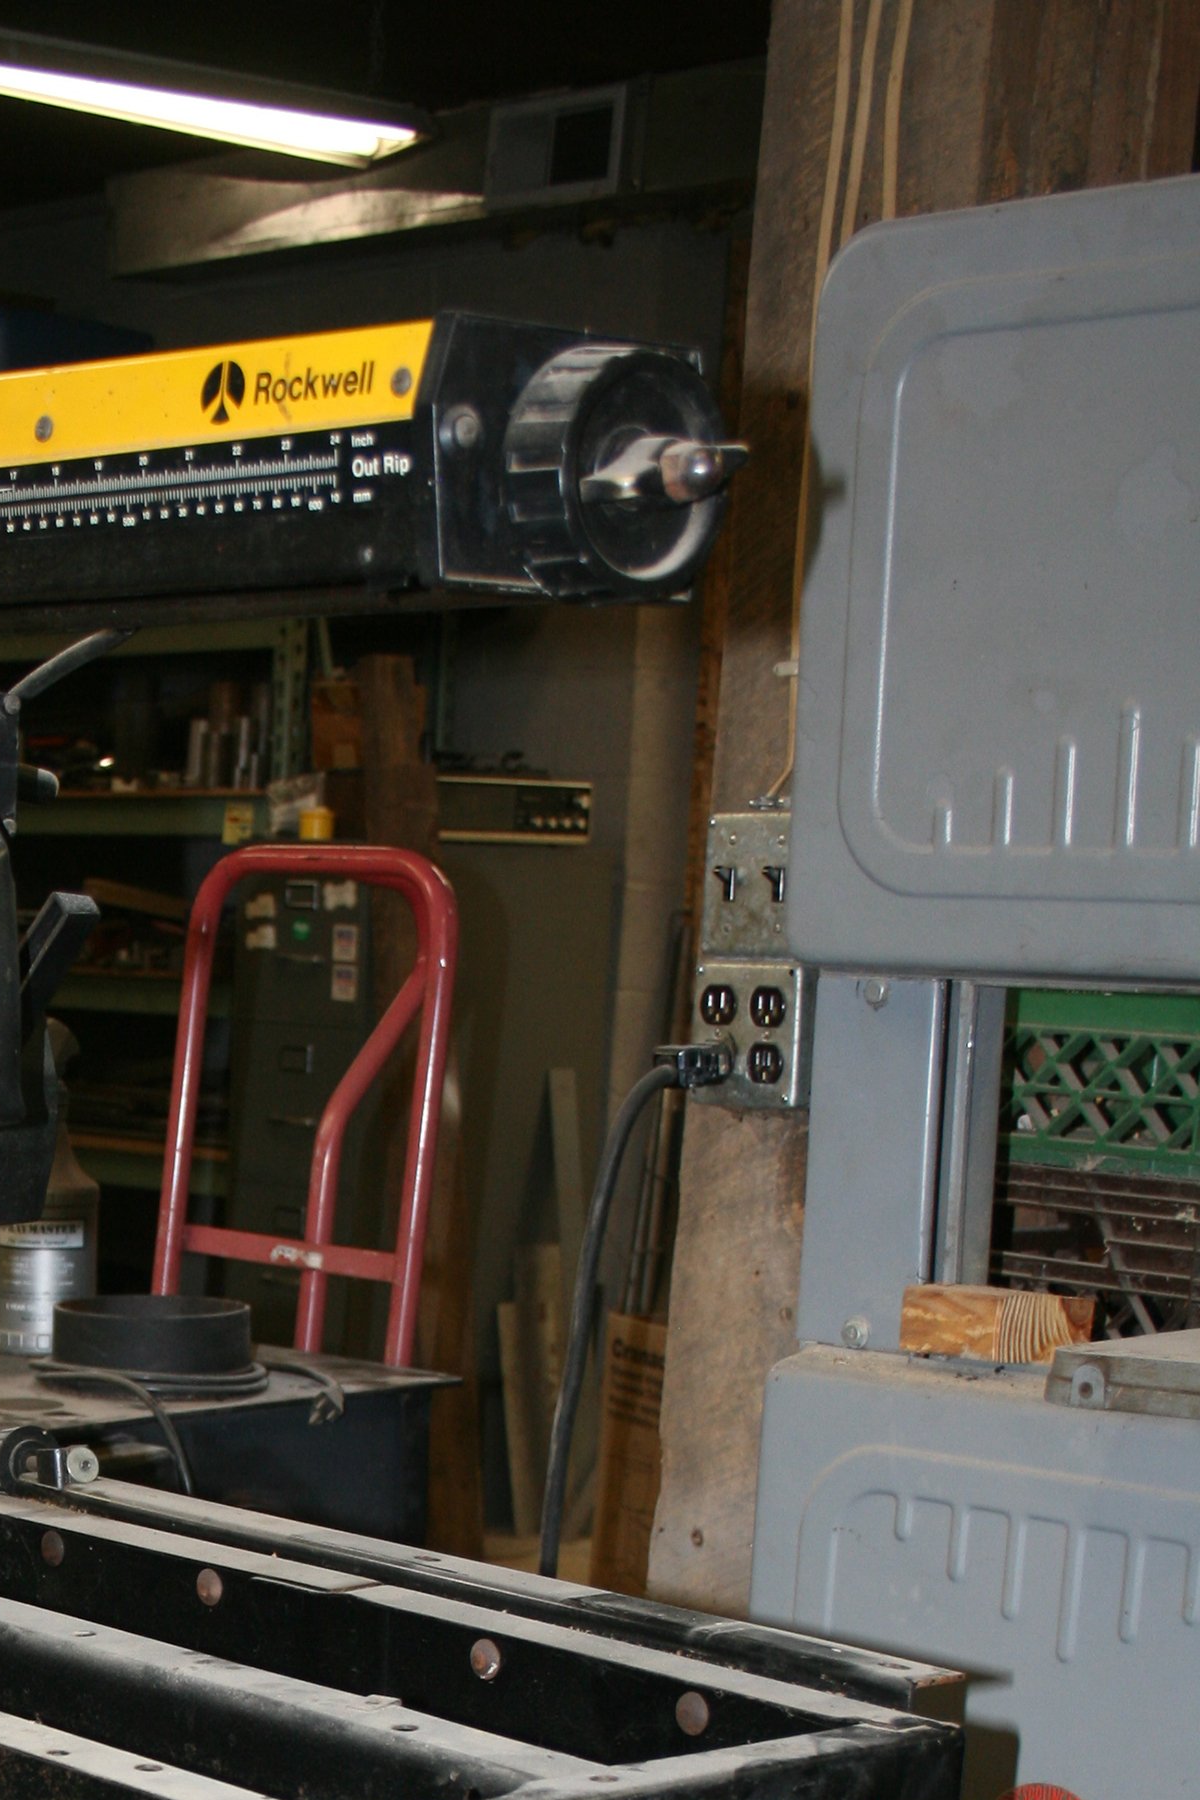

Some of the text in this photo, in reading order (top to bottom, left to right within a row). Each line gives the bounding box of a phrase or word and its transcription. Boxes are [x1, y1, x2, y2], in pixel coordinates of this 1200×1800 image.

[253, 361, 375, 405] Rockwell
[351, 434, 374, 447] Inch
[9, 471, 18, 480] 17
[52, 466, 60, 476] 18
[94, 461, 103, 471] 19
[139, 455, 148, 466] 20
[185, 450, 193, 461] 21
[232, 445, 242, 456] 22
[281, 440, 291, 451] 23
[330, 434, 341, 446] 24
[351, 454, 410, 478] Out Rip
[122, 516, 136, 527] 500
[142, 511, 151, 520] 10
[160, 509, 169, 519] 20
[178, 507, 187, 518] 30
[196, 505, 205, 516] 40
[215, 504, 224, 514] 50
[253, 500, 262, 510] 70
[272, 498, 281, 509] 80
[308, 500, 323, 511] 600
[331, 493, 340, 503] 10
[353, 492, 371, 503] mm
